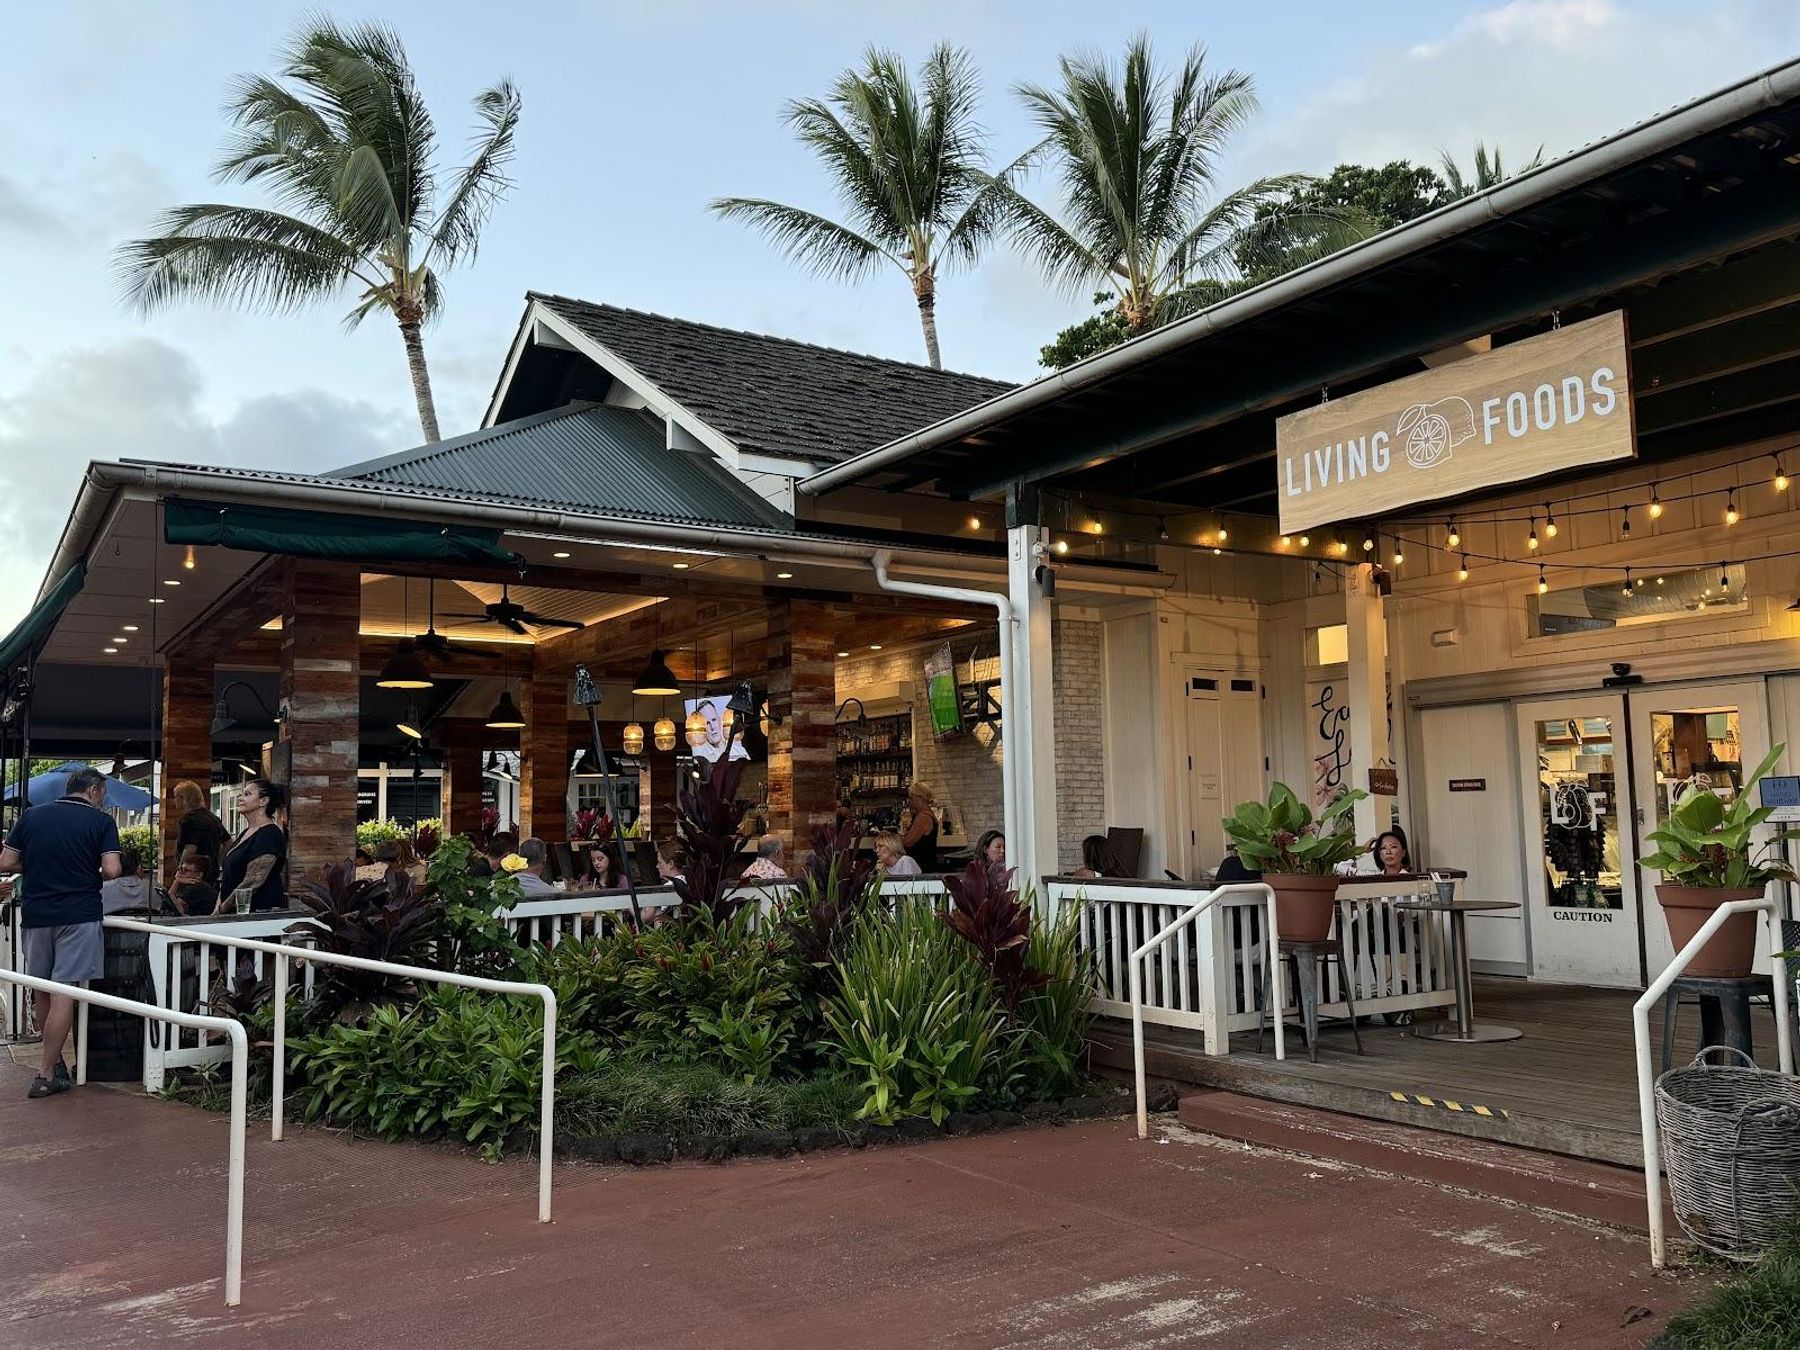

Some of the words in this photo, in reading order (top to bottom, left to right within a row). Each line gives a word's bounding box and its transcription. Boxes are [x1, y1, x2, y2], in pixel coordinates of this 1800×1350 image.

[1285, 431, 1391, 497] LIVING
[1482, 367, 1616, 444] FOODS
[1553, 911, 1613, 923] CAUTION
